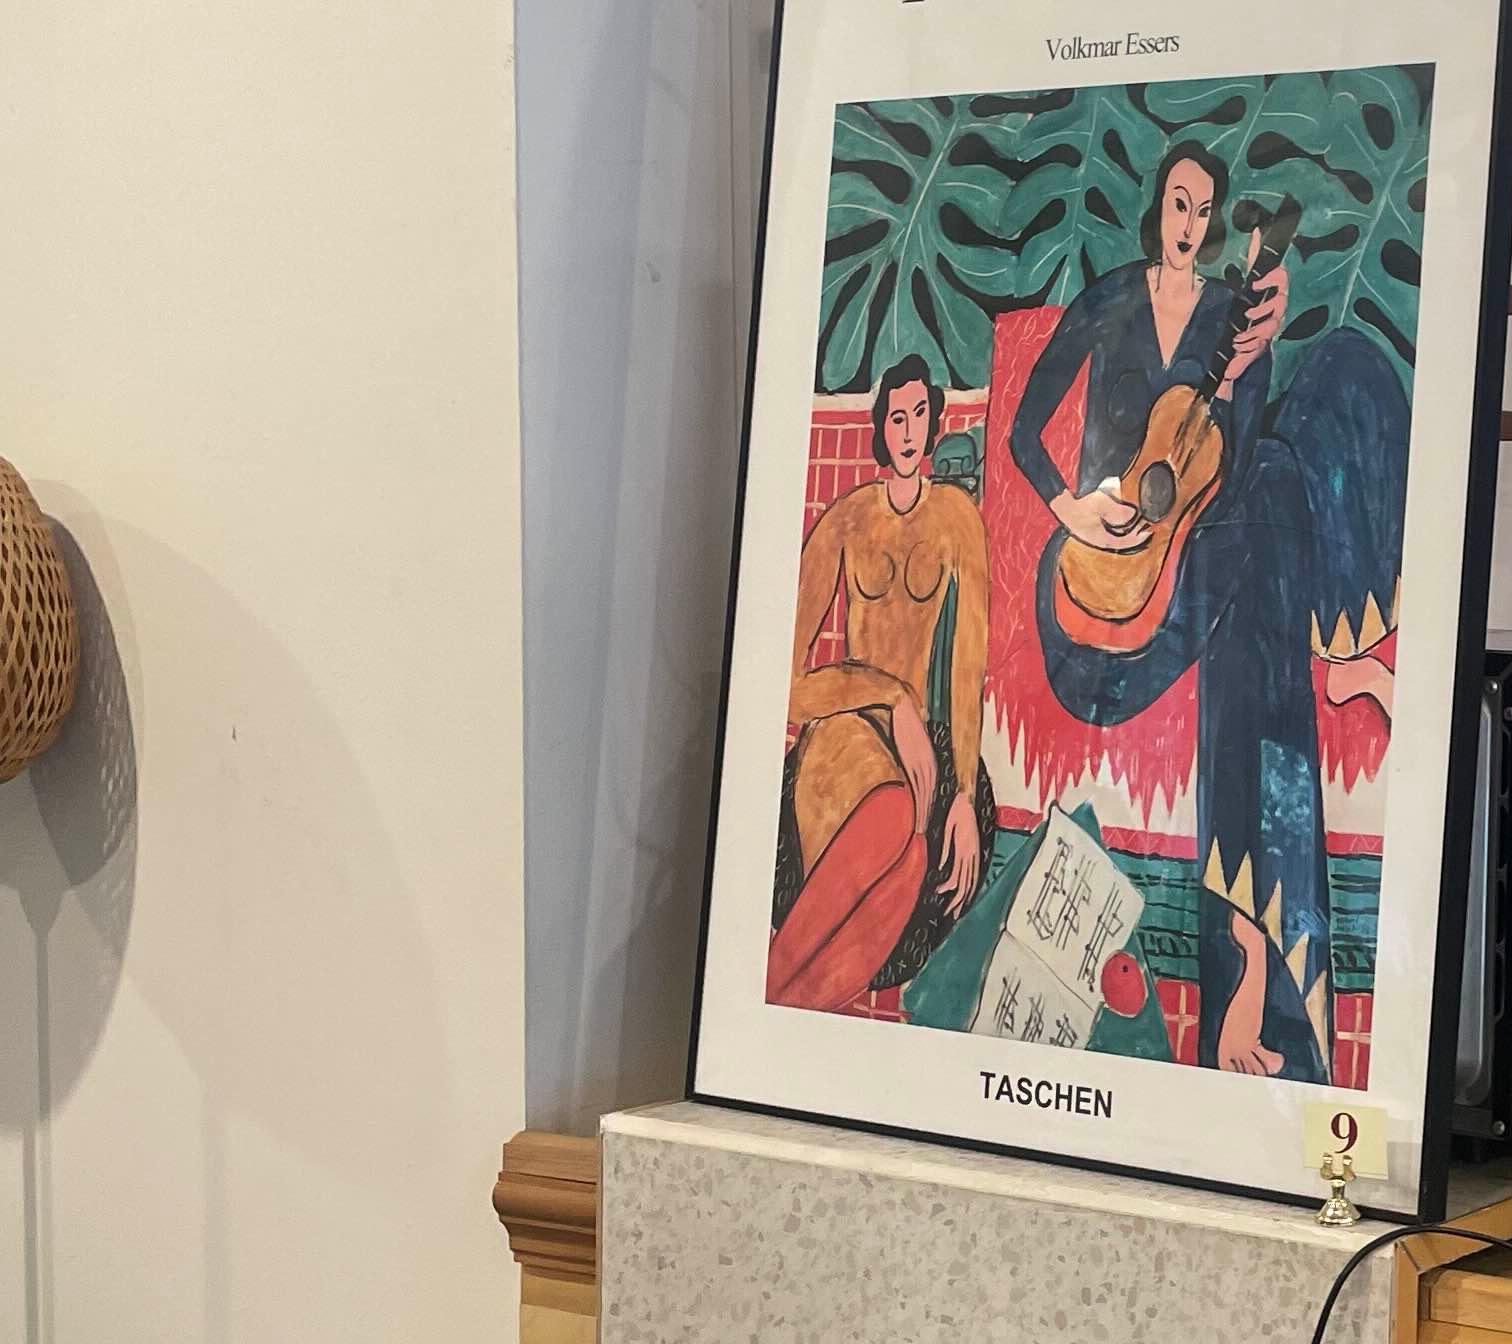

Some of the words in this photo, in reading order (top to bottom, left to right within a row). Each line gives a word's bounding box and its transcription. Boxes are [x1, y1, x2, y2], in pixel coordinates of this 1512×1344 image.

[1046, 35, 1122, 62] Volkmar
[1125, 32, 1180, 56] Essers
[980, 1071, 1113, 1119] TASCHEN
[1330, 1112, 1359, 1154] 9
